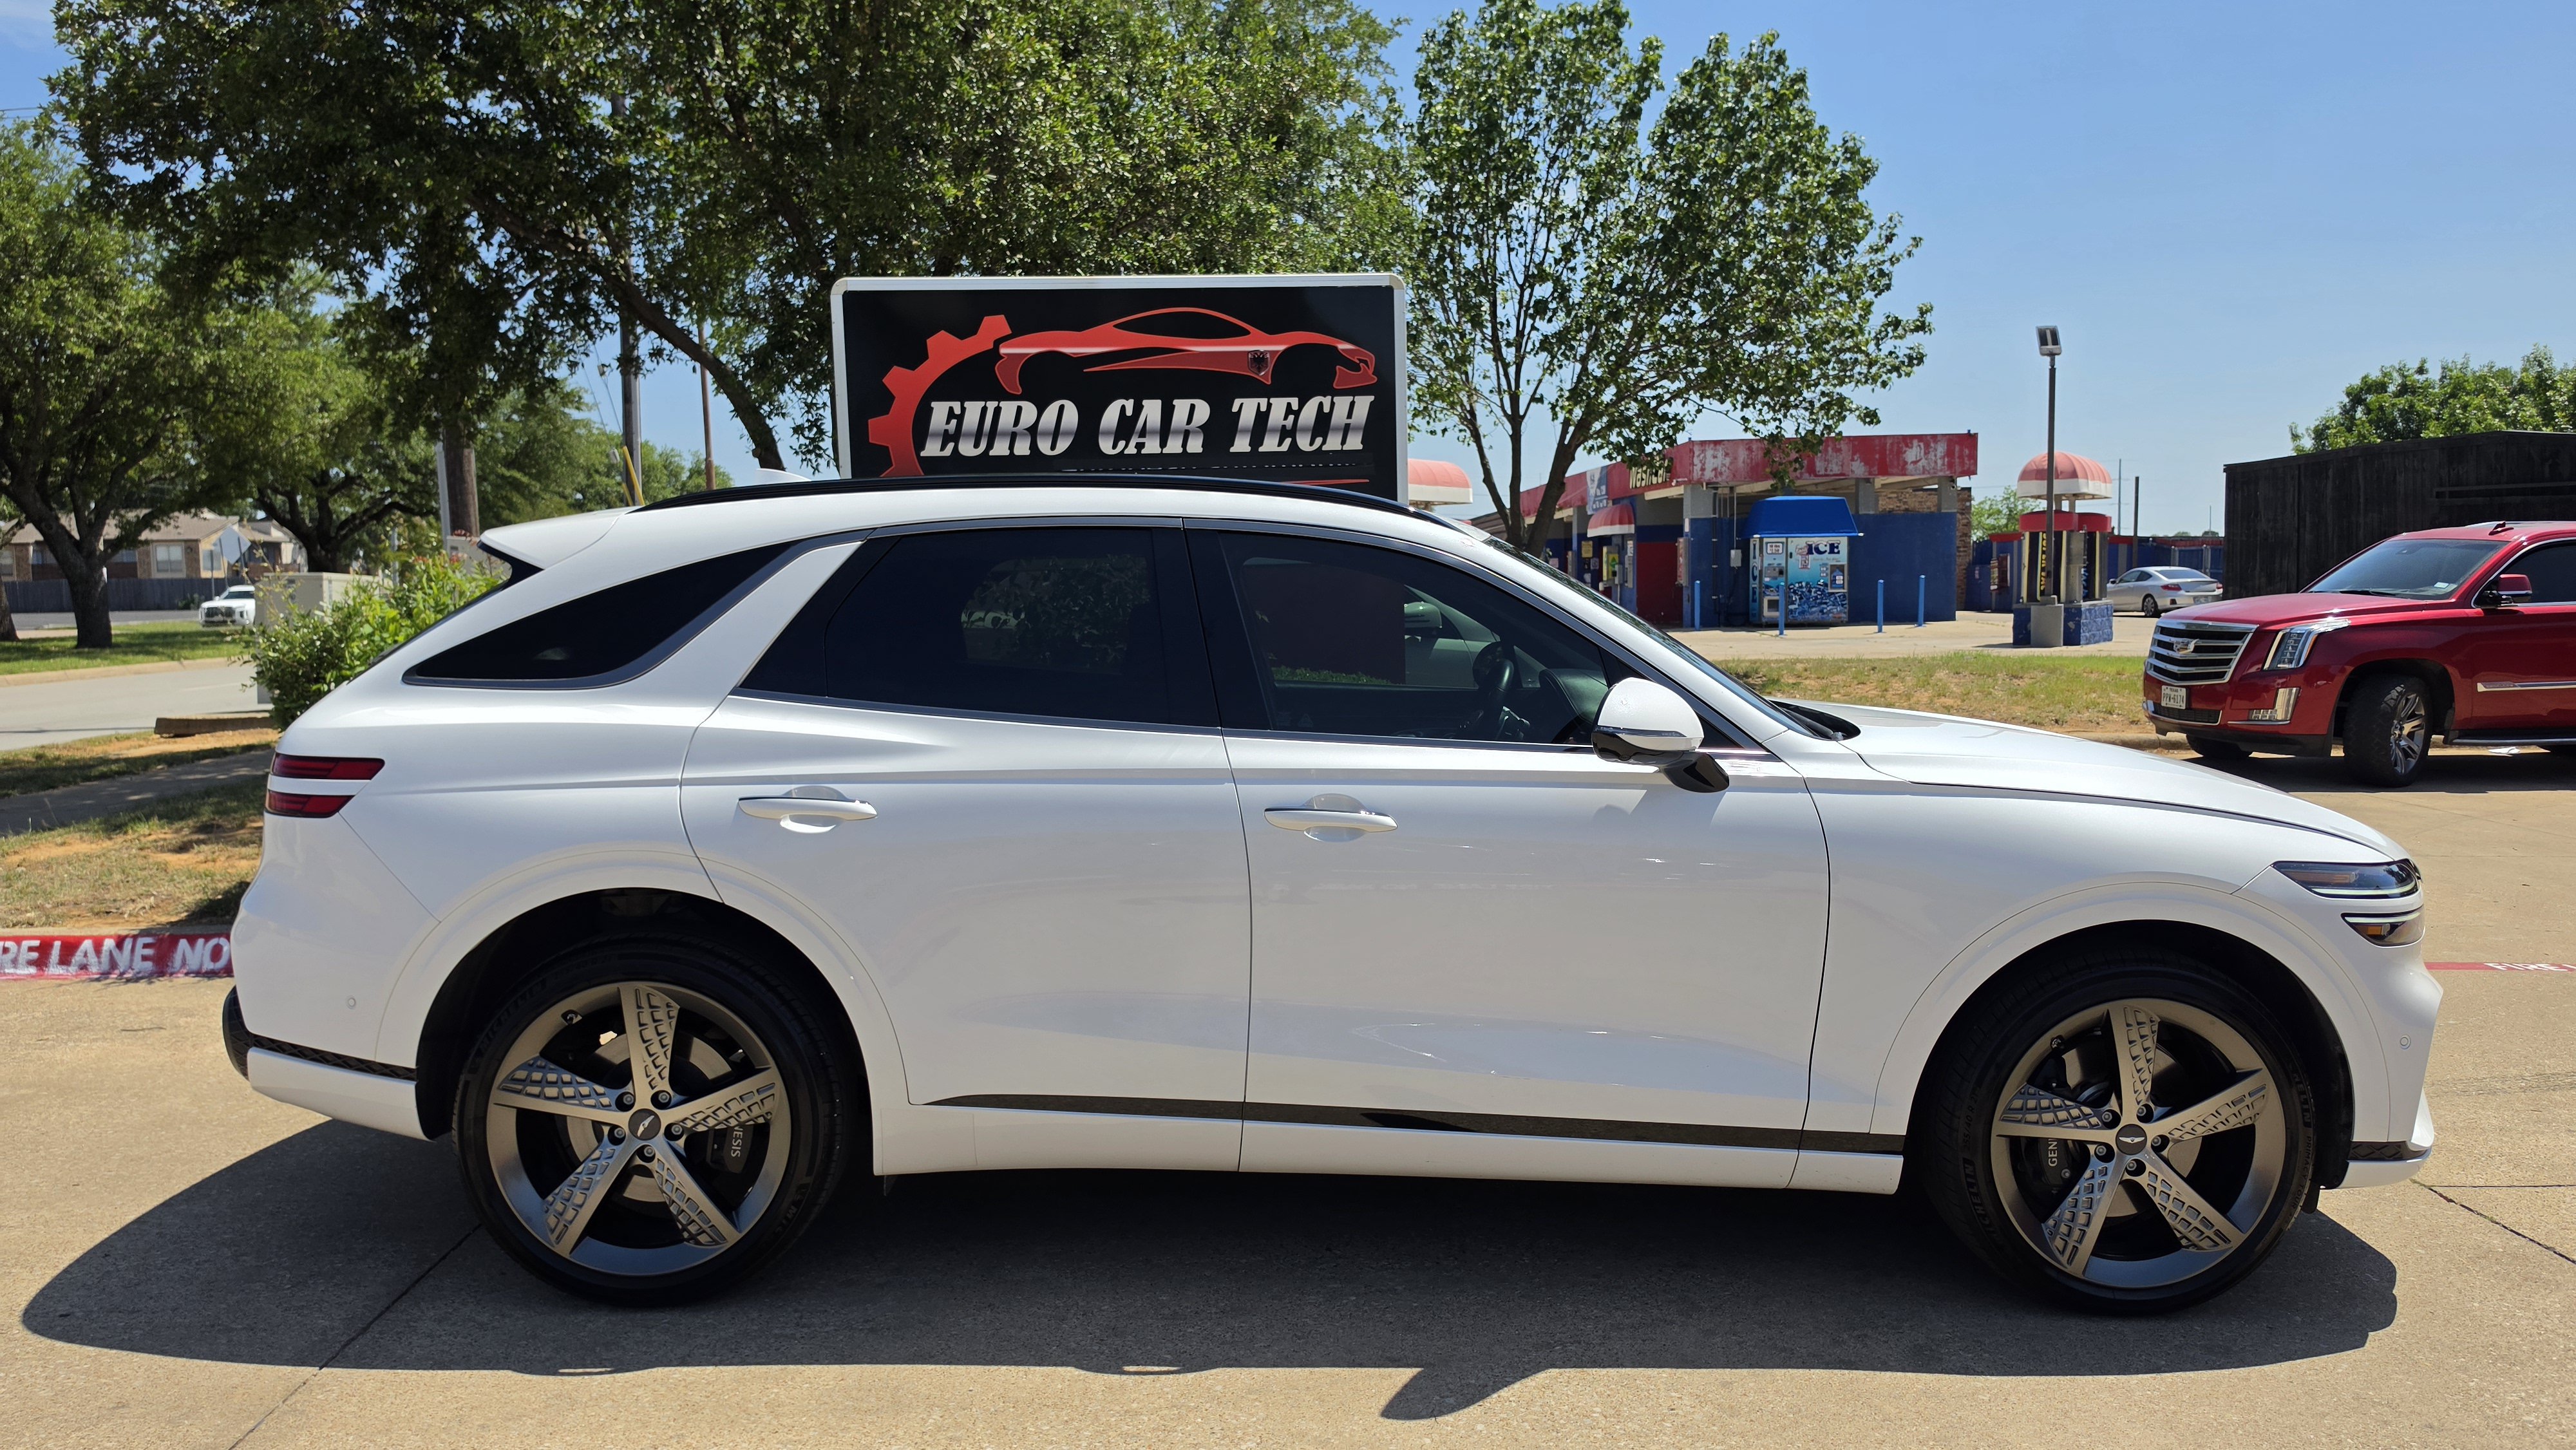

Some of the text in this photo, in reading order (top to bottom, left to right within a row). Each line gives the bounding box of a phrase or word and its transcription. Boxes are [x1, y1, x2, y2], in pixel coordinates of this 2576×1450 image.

[920, 395, 1375, 457] EURO CAR TECH
[1805, 540, 1841, 555] ICE
[47, 937, 155, 975] LANE
[170, 937, 231, 972] NO
[2483, 963, 2568, 971] FIRE
[2048, 1138, 2058, 1167] GEN
[2302, 1136, 2311, 1180] PRIMACY
